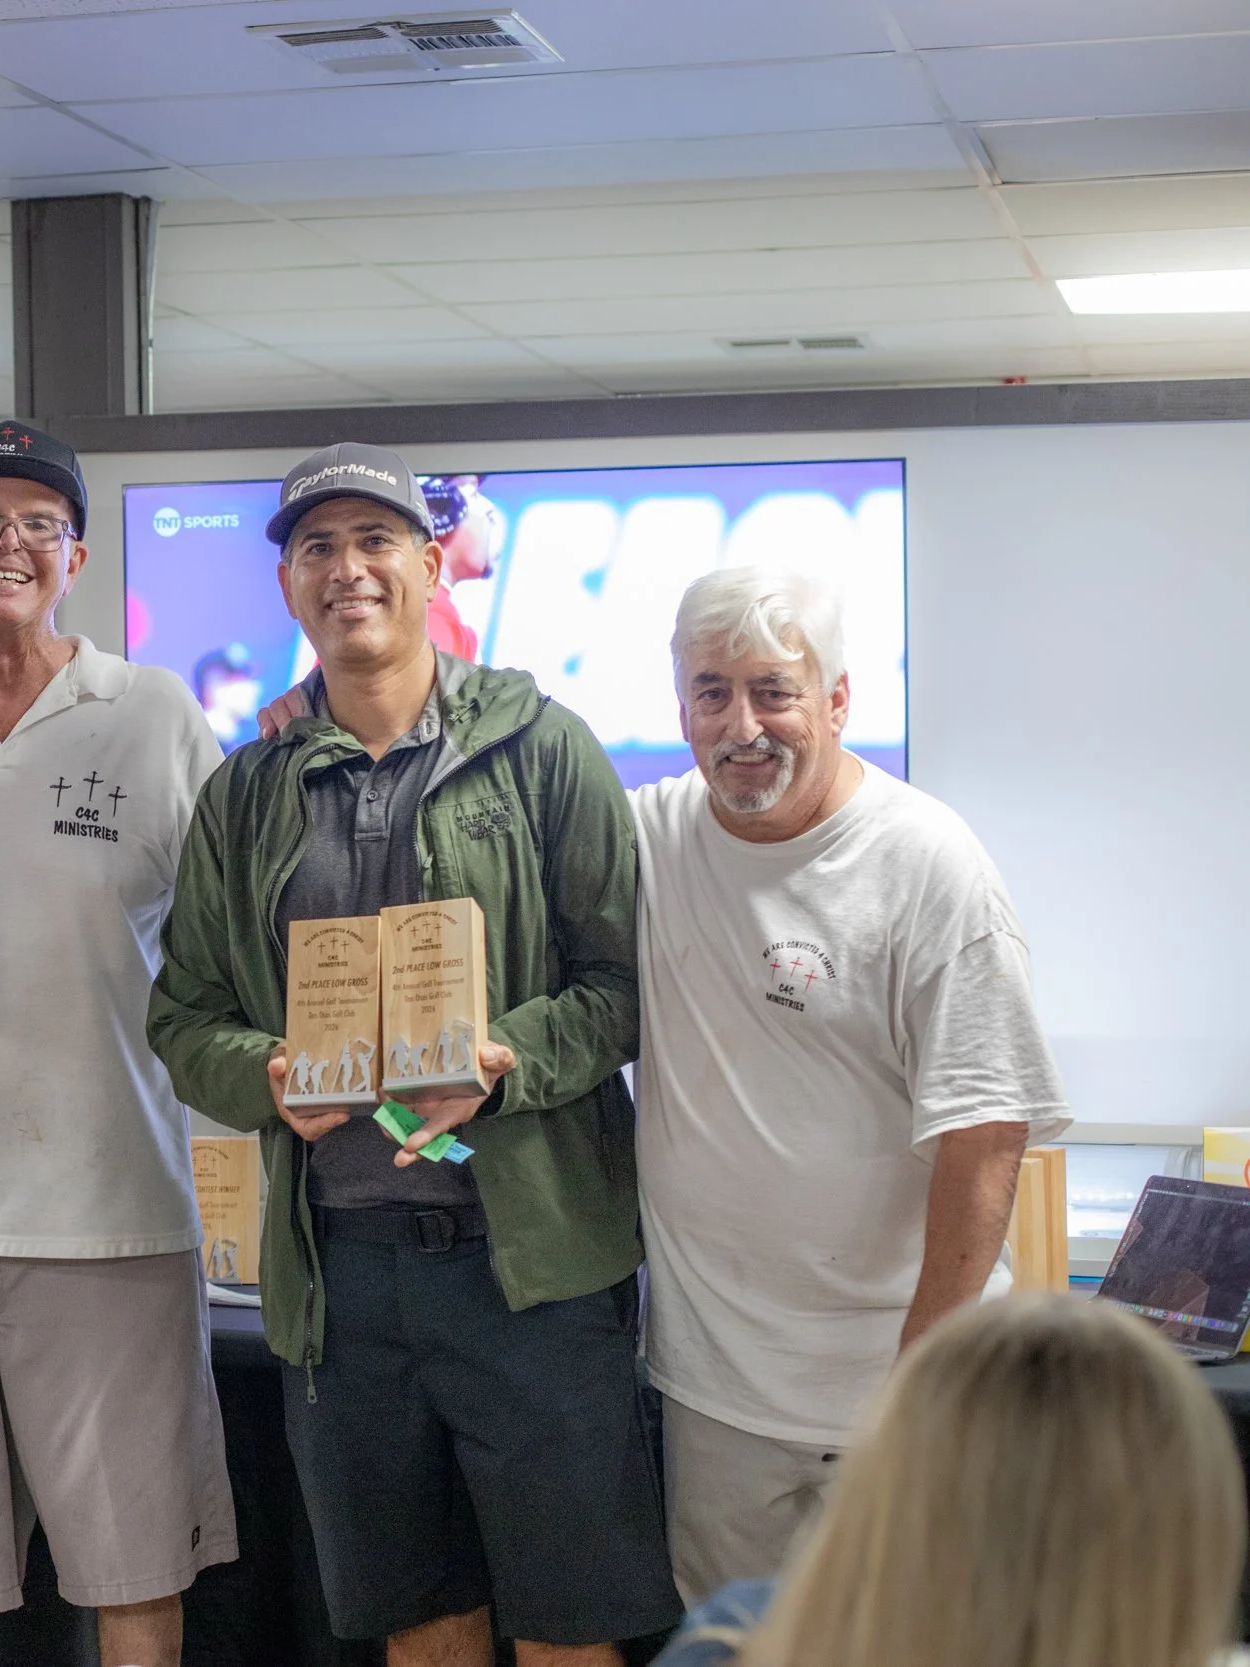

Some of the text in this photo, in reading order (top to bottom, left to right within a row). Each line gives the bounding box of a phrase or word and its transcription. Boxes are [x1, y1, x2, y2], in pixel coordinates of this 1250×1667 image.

[288, 463, 398, 501] TaylorMade
[183, 514, 240, 529] SPORTS
[75, 806, 100, 822] C4C
[456, 804, 510, 822] MOUNTAIN
[53, 820, 119, 842] MINISTRIES
[392, 959, 464, 974] 2nd PLACE LOW GROSS
[771, 941, 785, 952] ARE
[786, 940, 819, 955] CONVICTED
[821, 957, 836, 979] CHRIST
[298, 977, 368, 990] 2nd PLACE LOW GROSS
[778, 983, 795, 996] C4C
[766, 992, 805, 1012] MINISTRIES
[219, 1185, 240, 1193] WINNER
